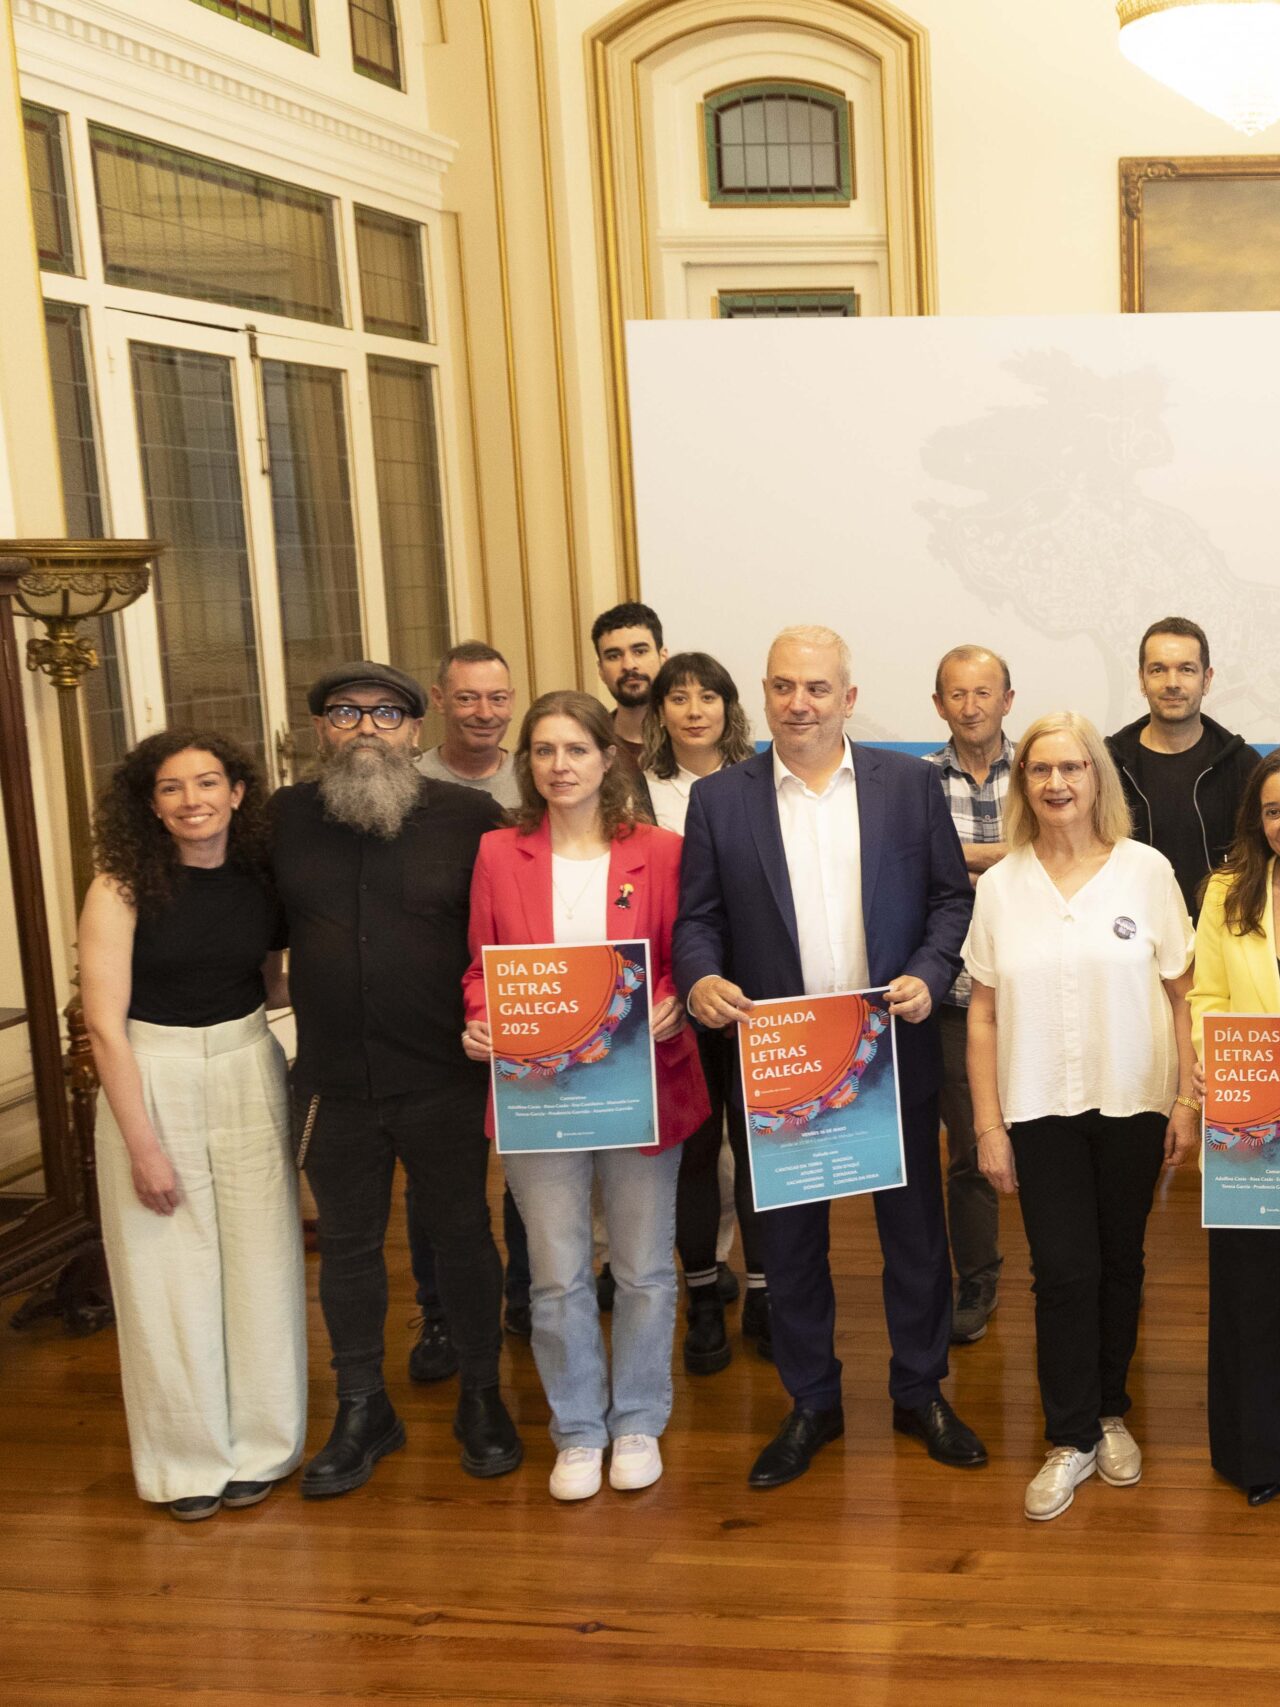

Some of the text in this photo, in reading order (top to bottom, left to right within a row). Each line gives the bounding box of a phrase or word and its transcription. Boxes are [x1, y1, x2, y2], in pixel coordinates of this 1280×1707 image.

[496, 959, 568, 976] DÍA DAS
[497, 980, 561, 996] LETRAS
[499, 999, 579, 1016] GALEGAS
[748, 1009, 816, 1029] FOLIADA
[500, 1021, 539, 1036] 2025
[1214, 1027, 1280, 1042] DÍA DAS
[749, 1031, 781, 1046] DAS
[750, 1044, 807, 1063] LETRAS
[1214, 1048, 1273, 1062] LETRAS
[751, 1059, 822, 1080] GALEGAS
[1214, 1089, 1251, 1102] 2025
